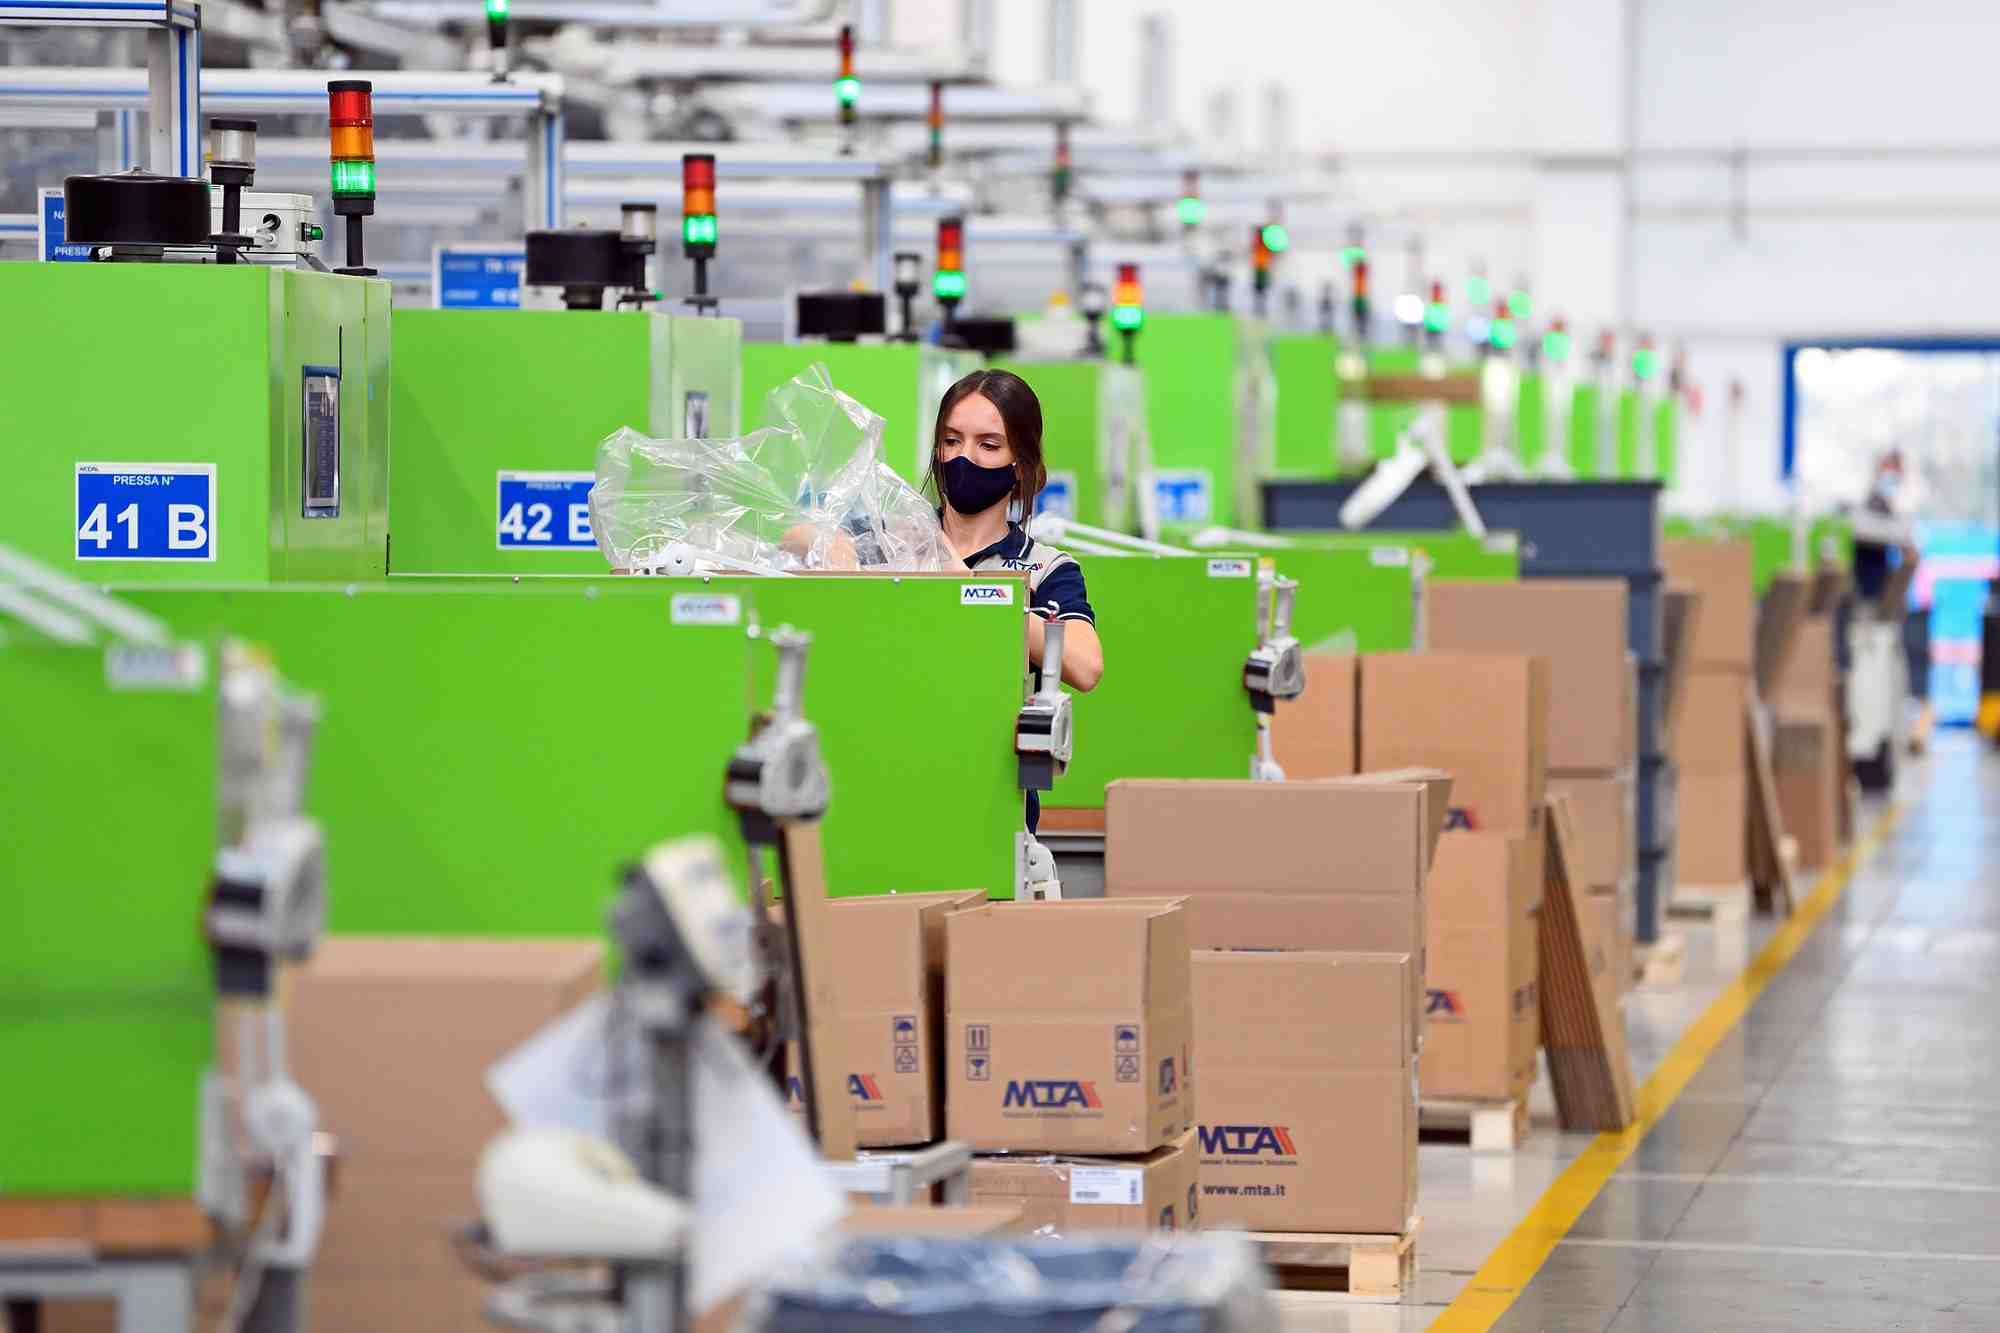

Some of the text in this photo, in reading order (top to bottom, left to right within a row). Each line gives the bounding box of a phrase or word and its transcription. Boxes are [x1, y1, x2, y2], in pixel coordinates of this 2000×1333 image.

[113, 475, 159, 486] PRESSA
[79, 503, 208, 550] 41 B
[498, 502, 553, 541] 42
[965, 588, 1003, 598] MTA
[1001, 1080, 1091, 1108] MTA
[1198, 1126, 1284, 1155] MTA
[1202, 1184, 1286, 1197] www.mta.it
